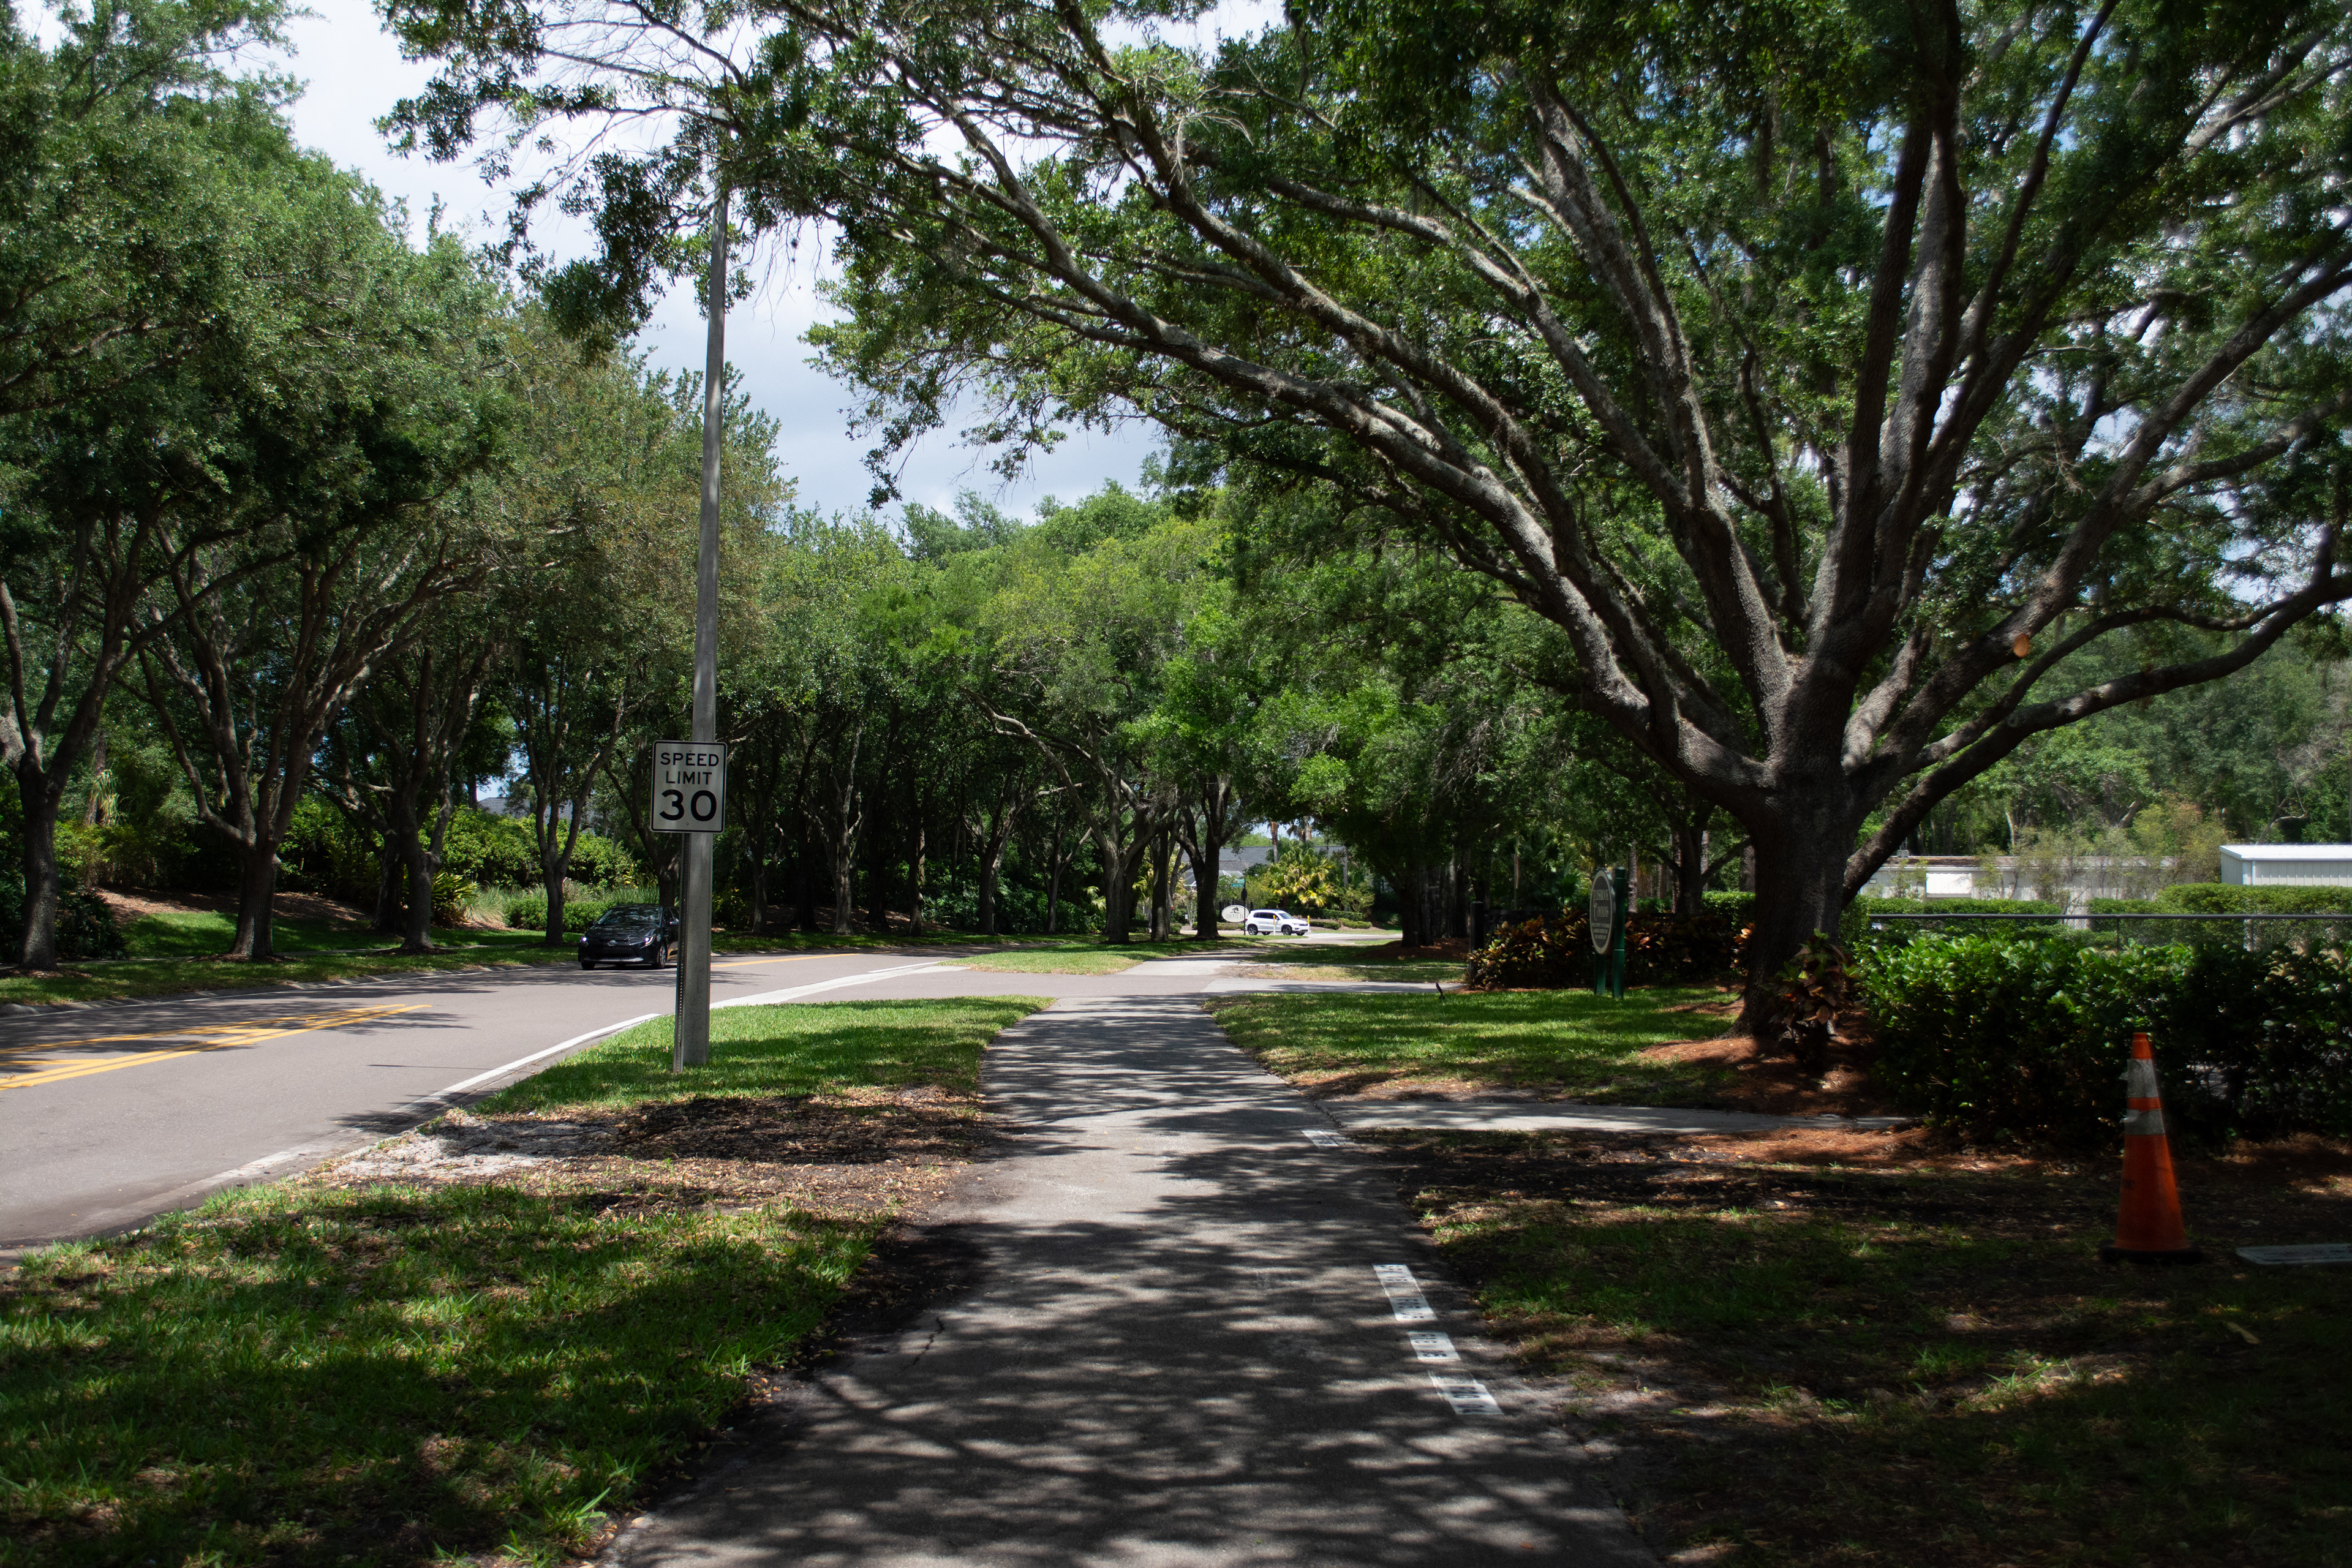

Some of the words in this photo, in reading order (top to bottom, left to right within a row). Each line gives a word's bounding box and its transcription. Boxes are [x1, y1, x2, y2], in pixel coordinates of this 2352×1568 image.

[660, 752, 719, 766] SPEED
[666, 771, 712, 785] LIMIT
[659, 789, 717, 822] 30
